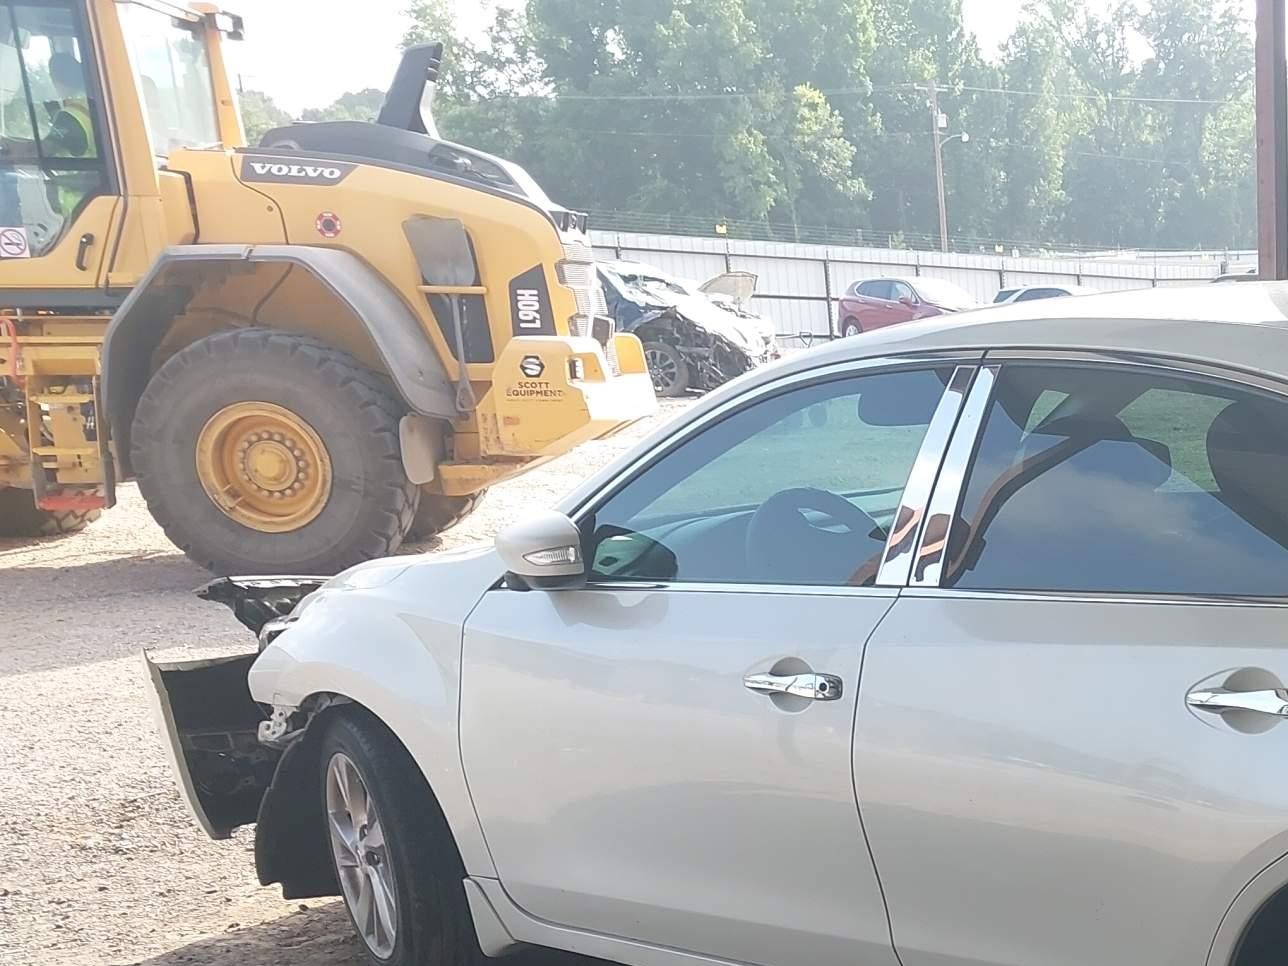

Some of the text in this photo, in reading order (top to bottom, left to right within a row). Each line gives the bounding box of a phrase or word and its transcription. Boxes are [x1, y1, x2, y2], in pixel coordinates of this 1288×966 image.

[250, 162, 342, 179] VOLVO
[516, 289, 542, 329] L90H
[517, 381, 550, 389] SCOTT
